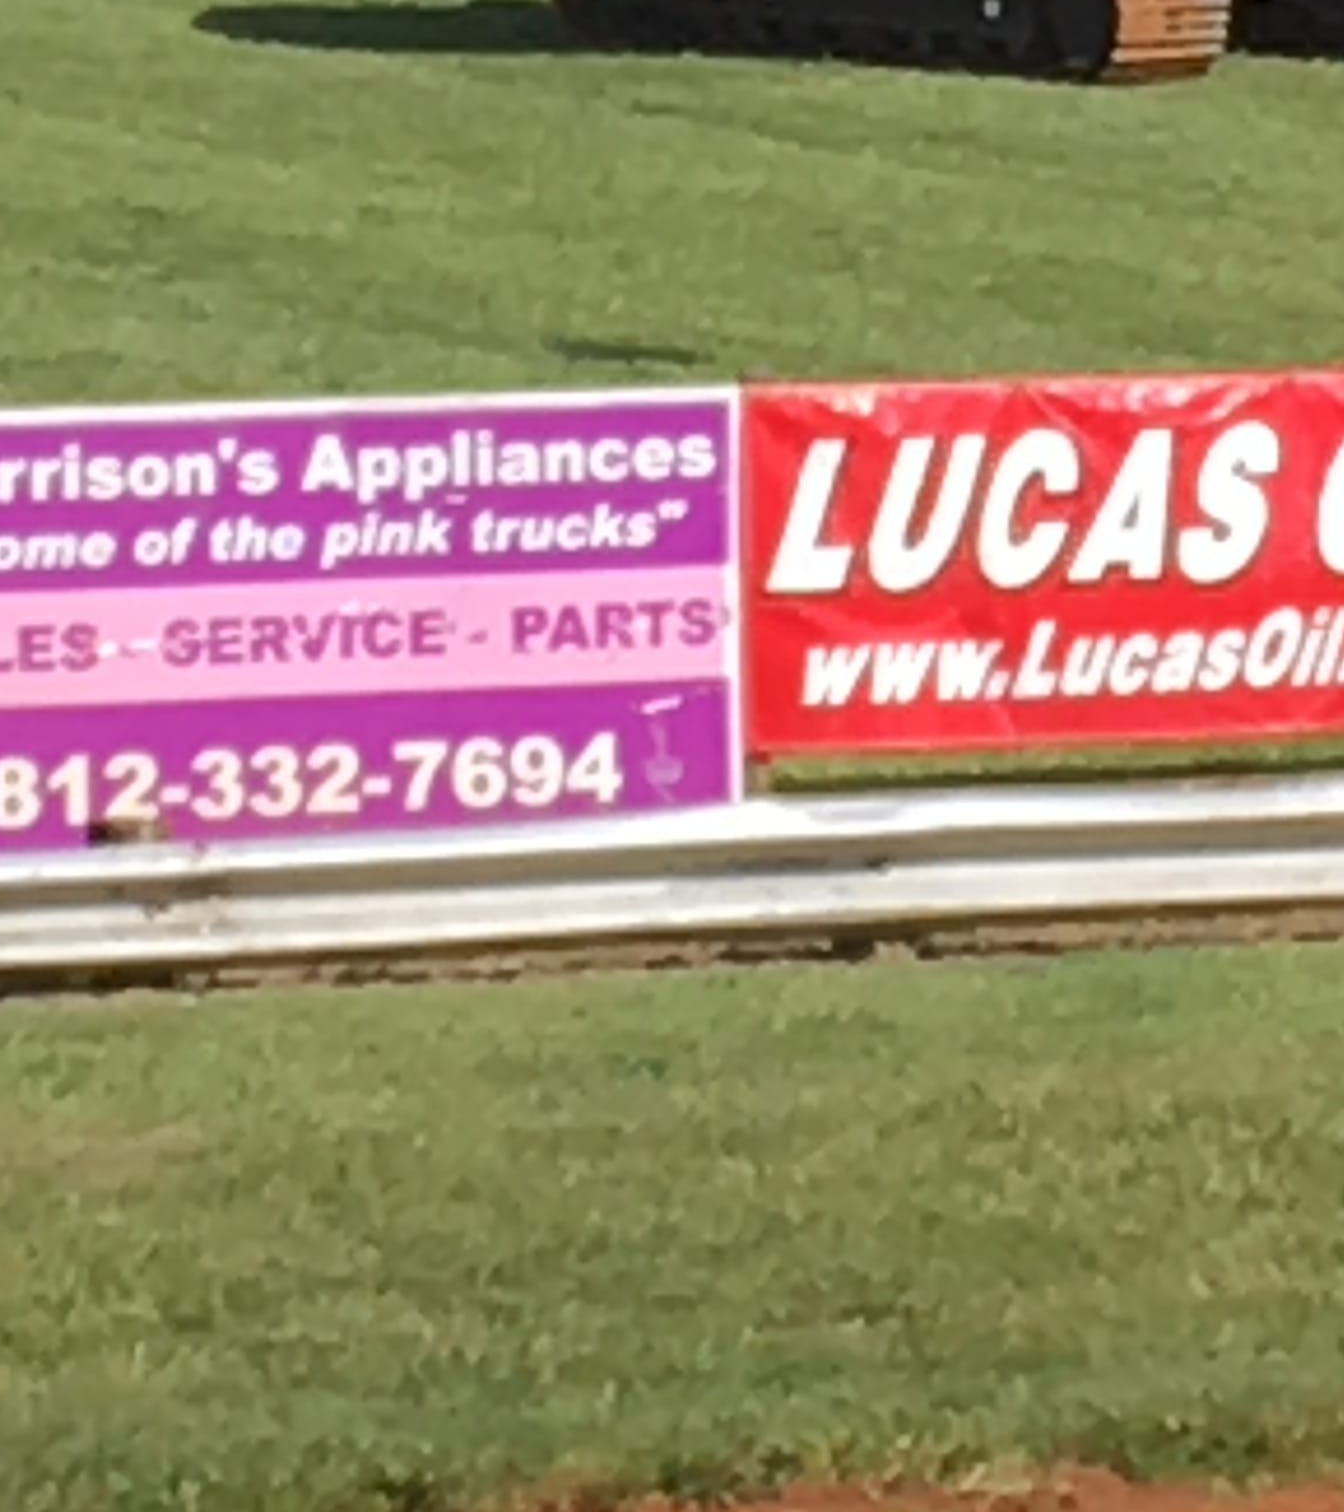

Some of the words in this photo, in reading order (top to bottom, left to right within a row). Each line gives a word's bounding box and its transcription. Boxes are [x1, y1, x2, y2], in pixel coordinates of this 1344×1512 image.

[300, 429, 718, 503] Appliances
[133, 516, 196, 565] of
[208, 511, 304, 562] the
[318, 509, 452, 569] pink
[766, 420, 1280, 594] LUCAS
[162, 608, 447, 669] SERVICE
[510, 597, 717, 656] PARTS
